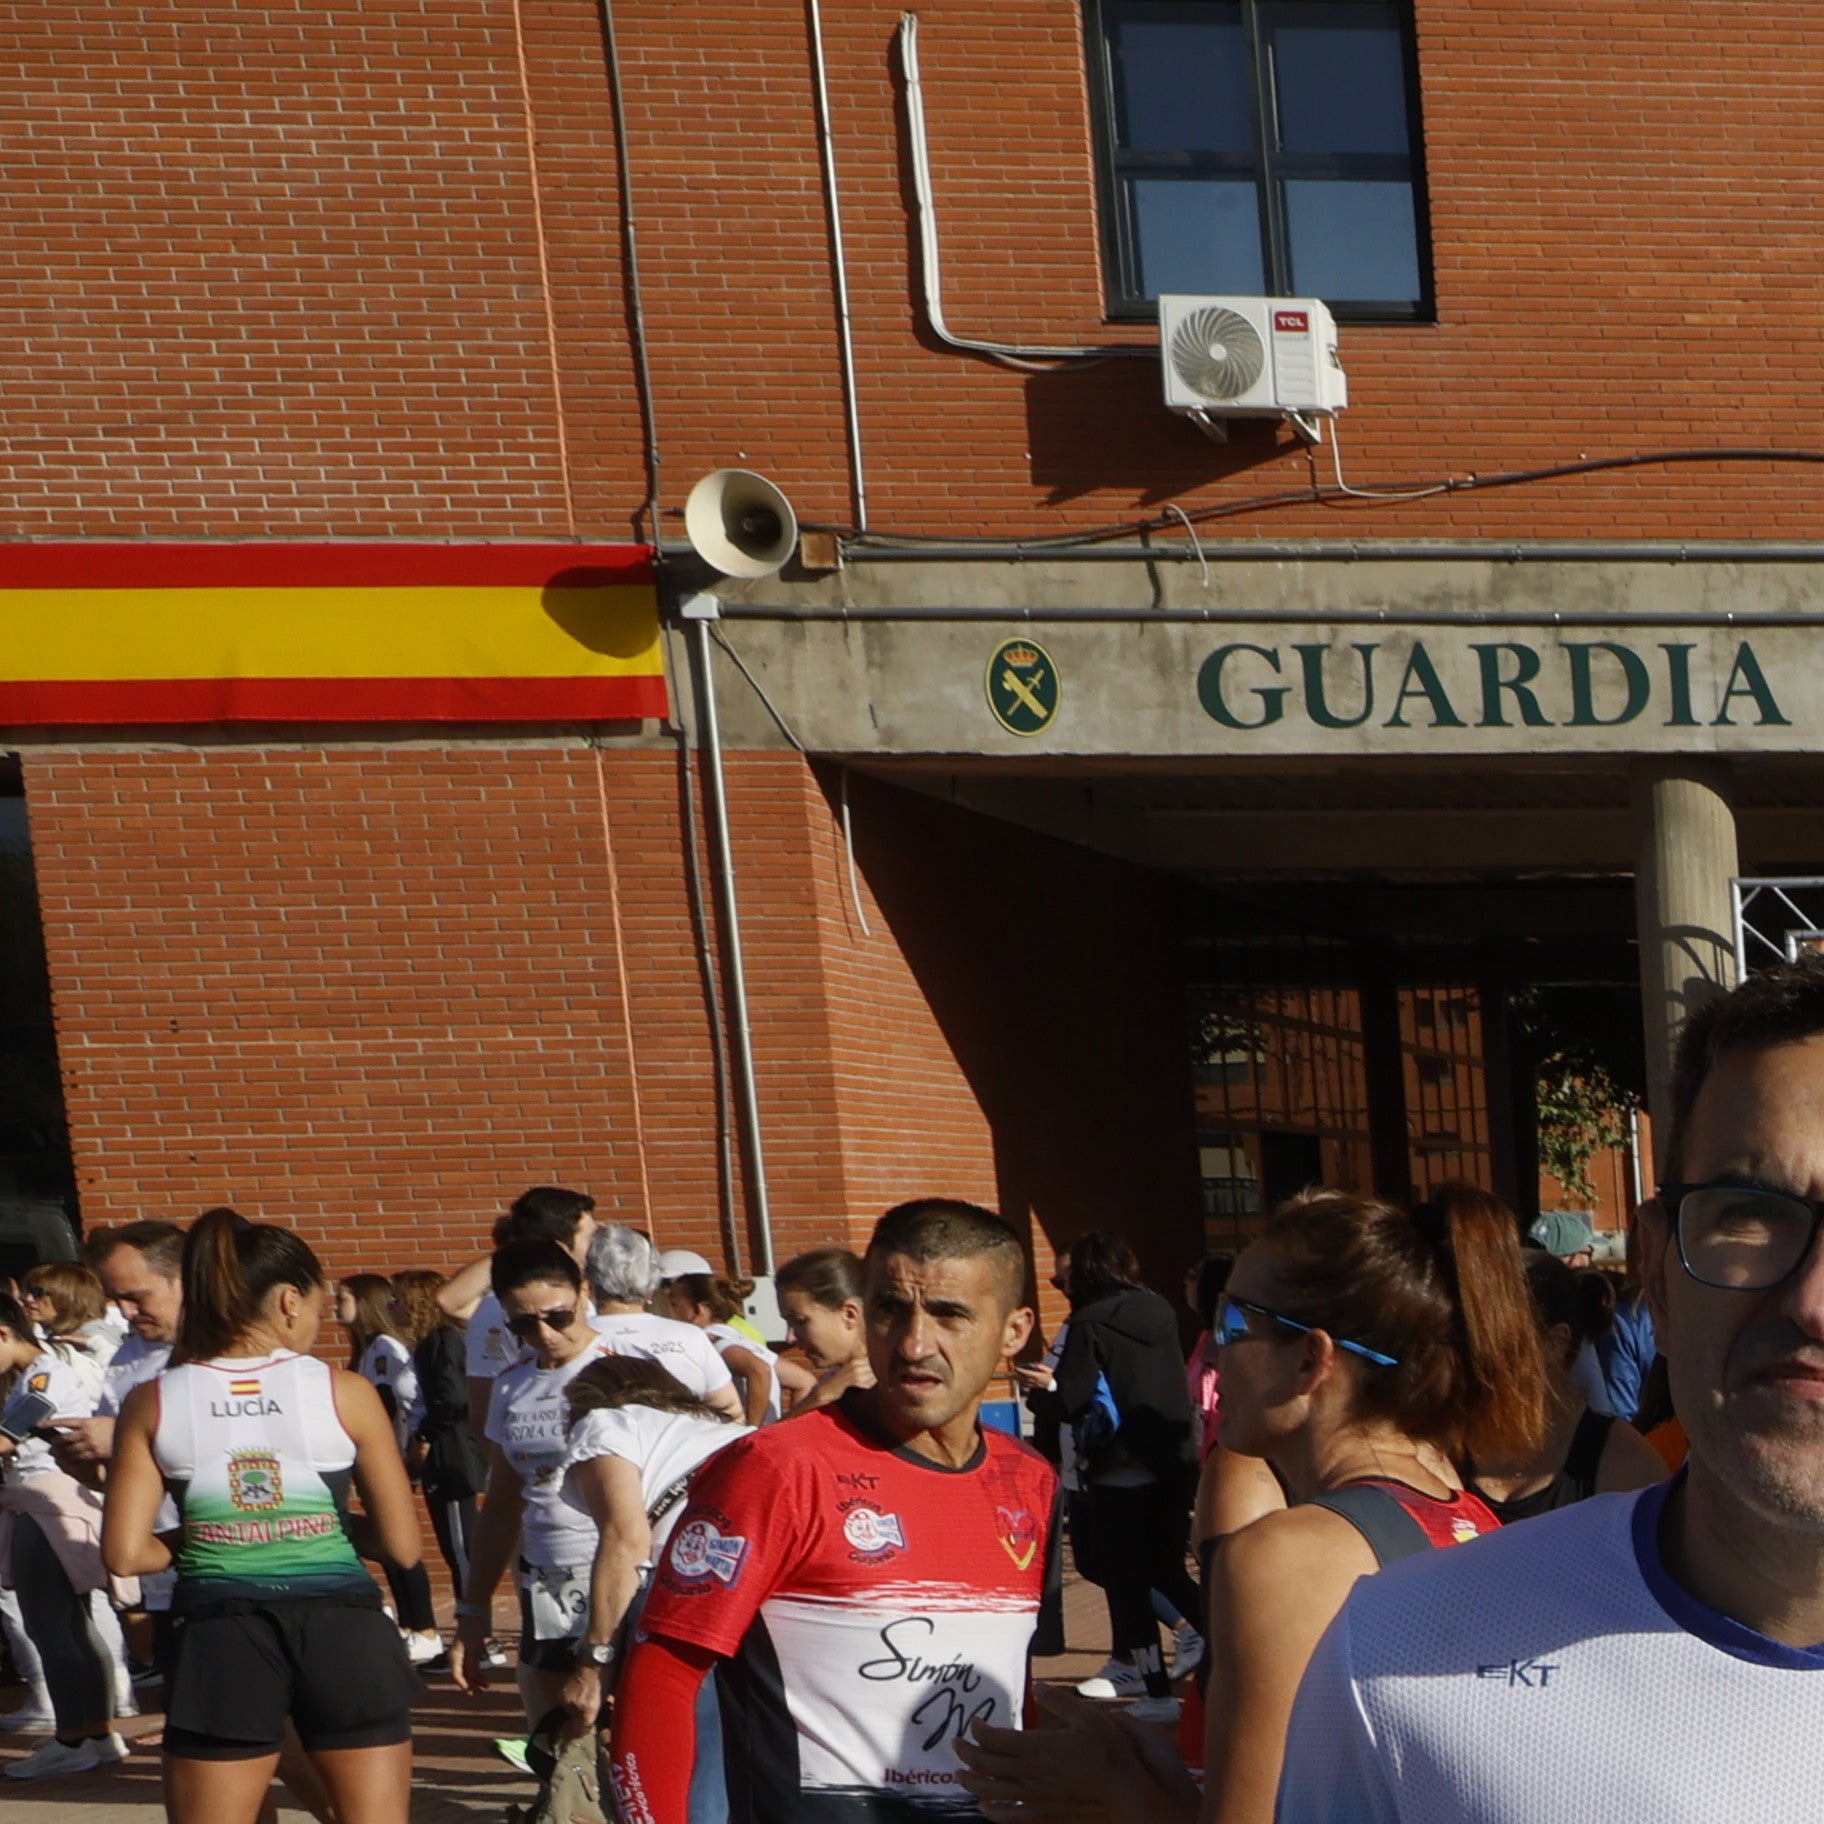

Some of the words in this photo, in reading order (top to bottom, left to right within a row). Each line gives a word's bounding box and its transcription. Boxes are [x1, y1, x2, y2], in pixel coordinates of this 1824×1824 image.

[1277, 316, 1305, 327] TCL
[1197, 640, 1793, 731] GUARDIA
[210, 1396, 283, 1417] LUCÍA
[858, 1617, 981, 1691] Simón
